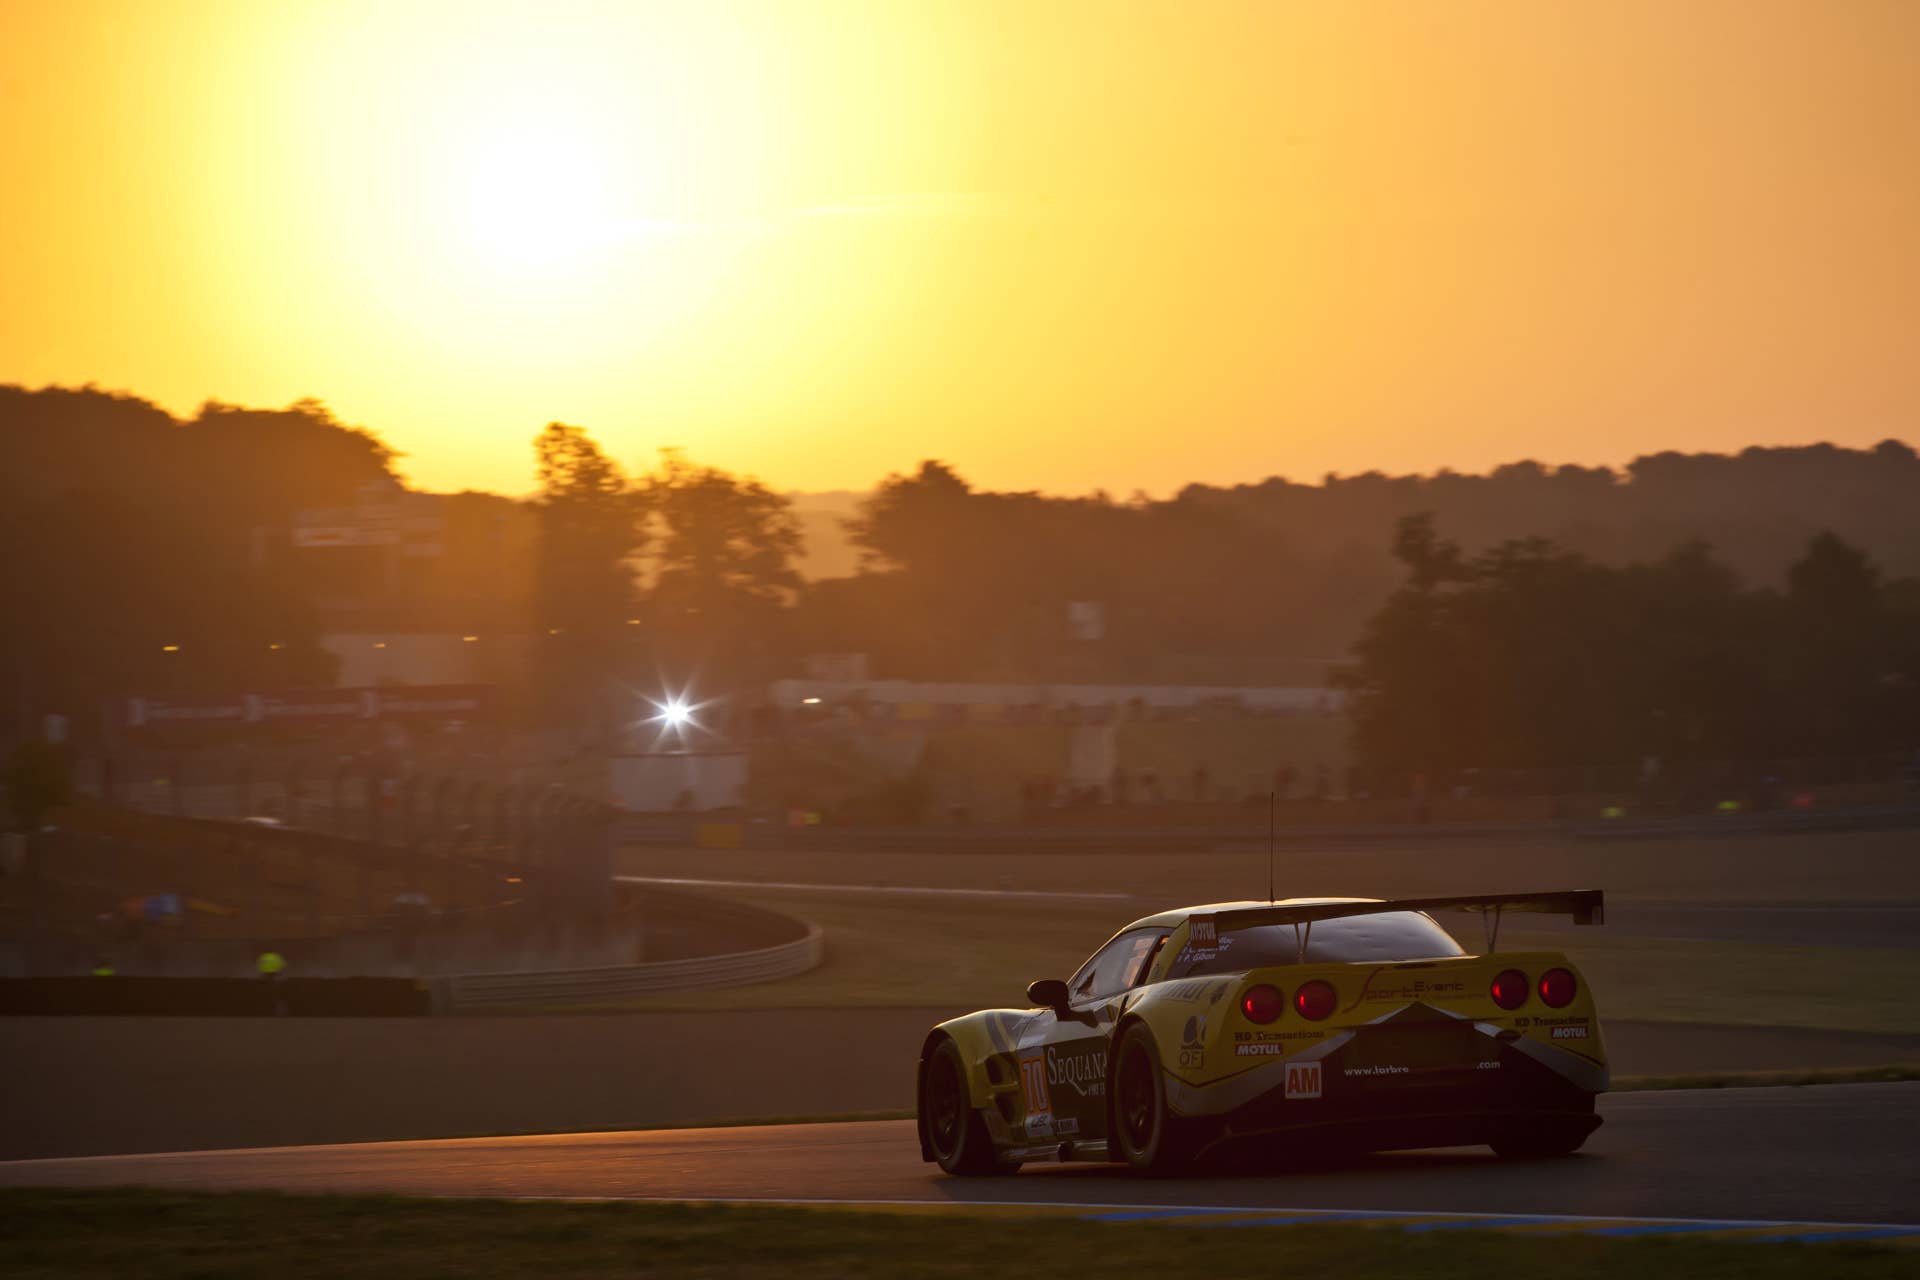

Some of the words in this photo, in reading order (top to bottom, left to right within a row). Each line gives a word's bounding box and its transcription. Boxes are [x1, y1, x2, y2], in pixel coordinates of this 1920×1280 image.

[1552, 1027, 1587, 1038] MOTUL
[1237, 1044, 1281, 1056] MOTUL
[1287, 1068, 1320, 1094] AM
